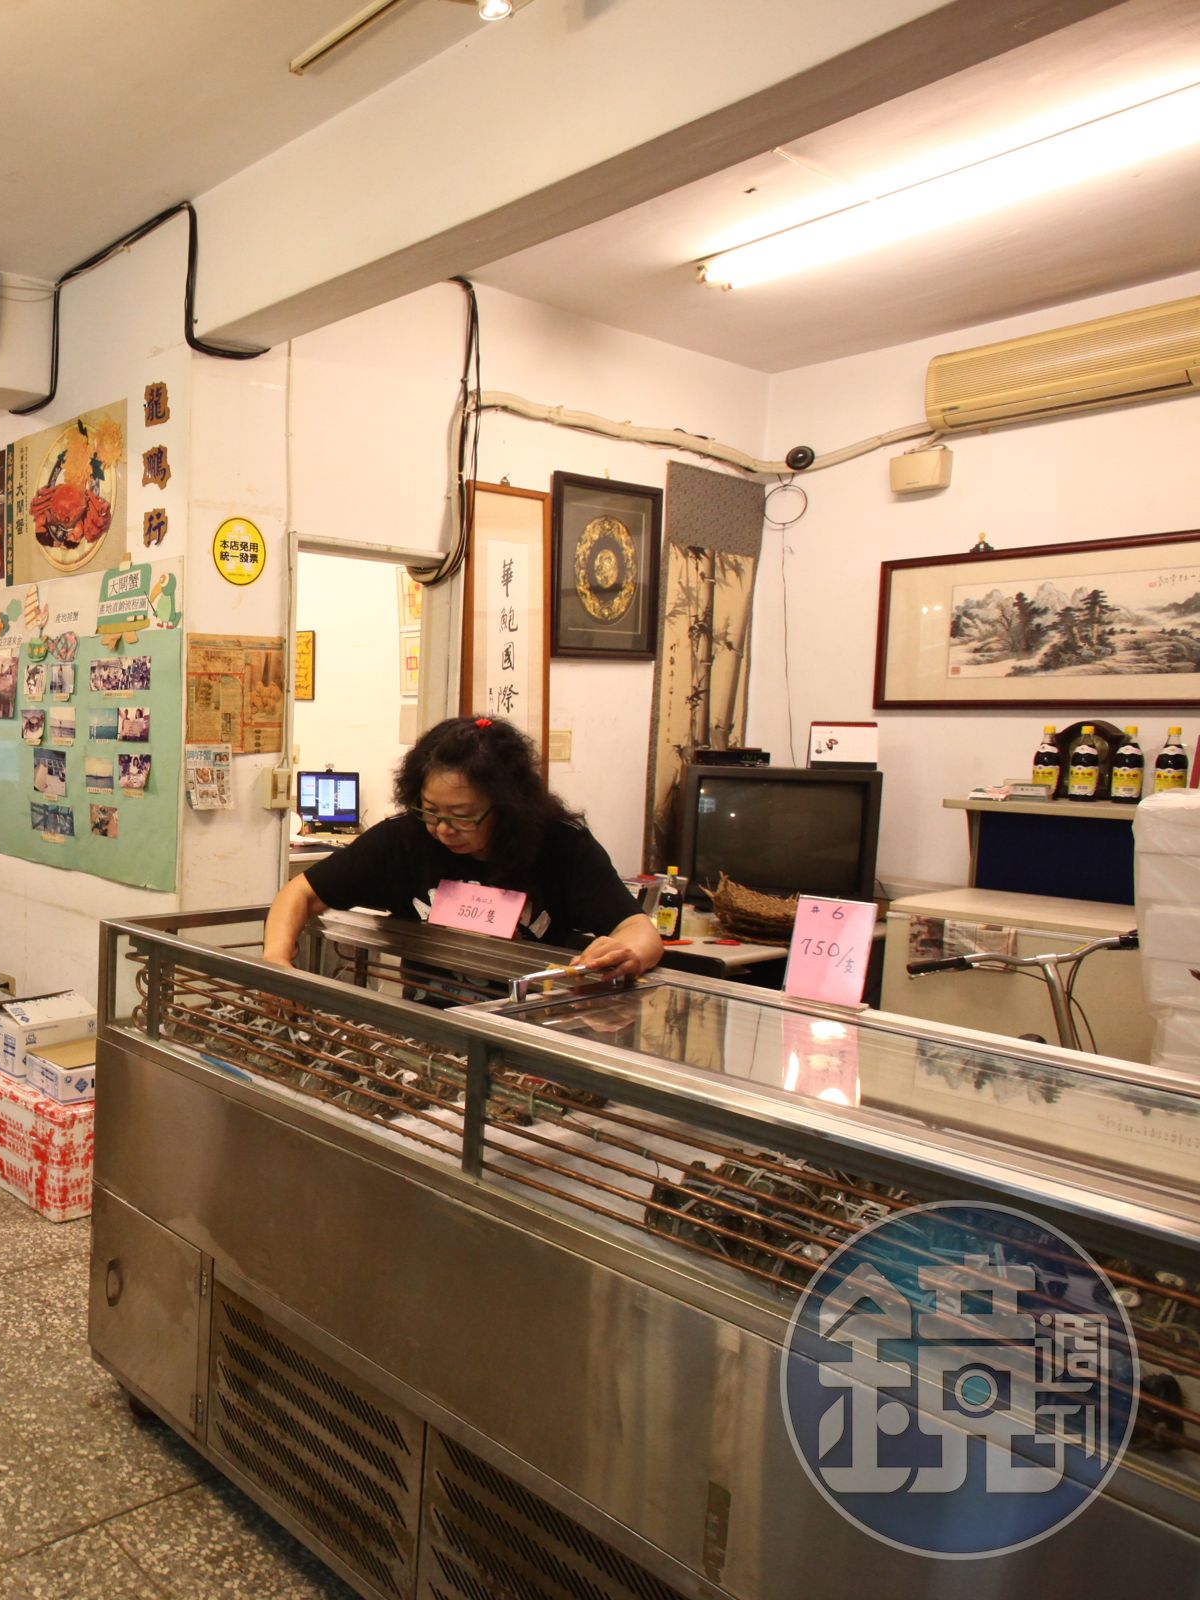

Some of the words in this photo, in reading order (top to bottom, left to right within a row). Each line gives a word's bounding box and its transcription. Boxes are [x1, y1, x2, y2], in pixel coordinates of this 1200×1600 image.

[146, 387, 166, 546] 龍鵬行
[219, 539, 259, 552] 本店免用
[219, 551, 259, 563] 統一發票
[109, 572, 140, 594] 大閘蟹
[496, 557, 519, 714] 華鮑國際
[832, 906, 844, 920] 6
